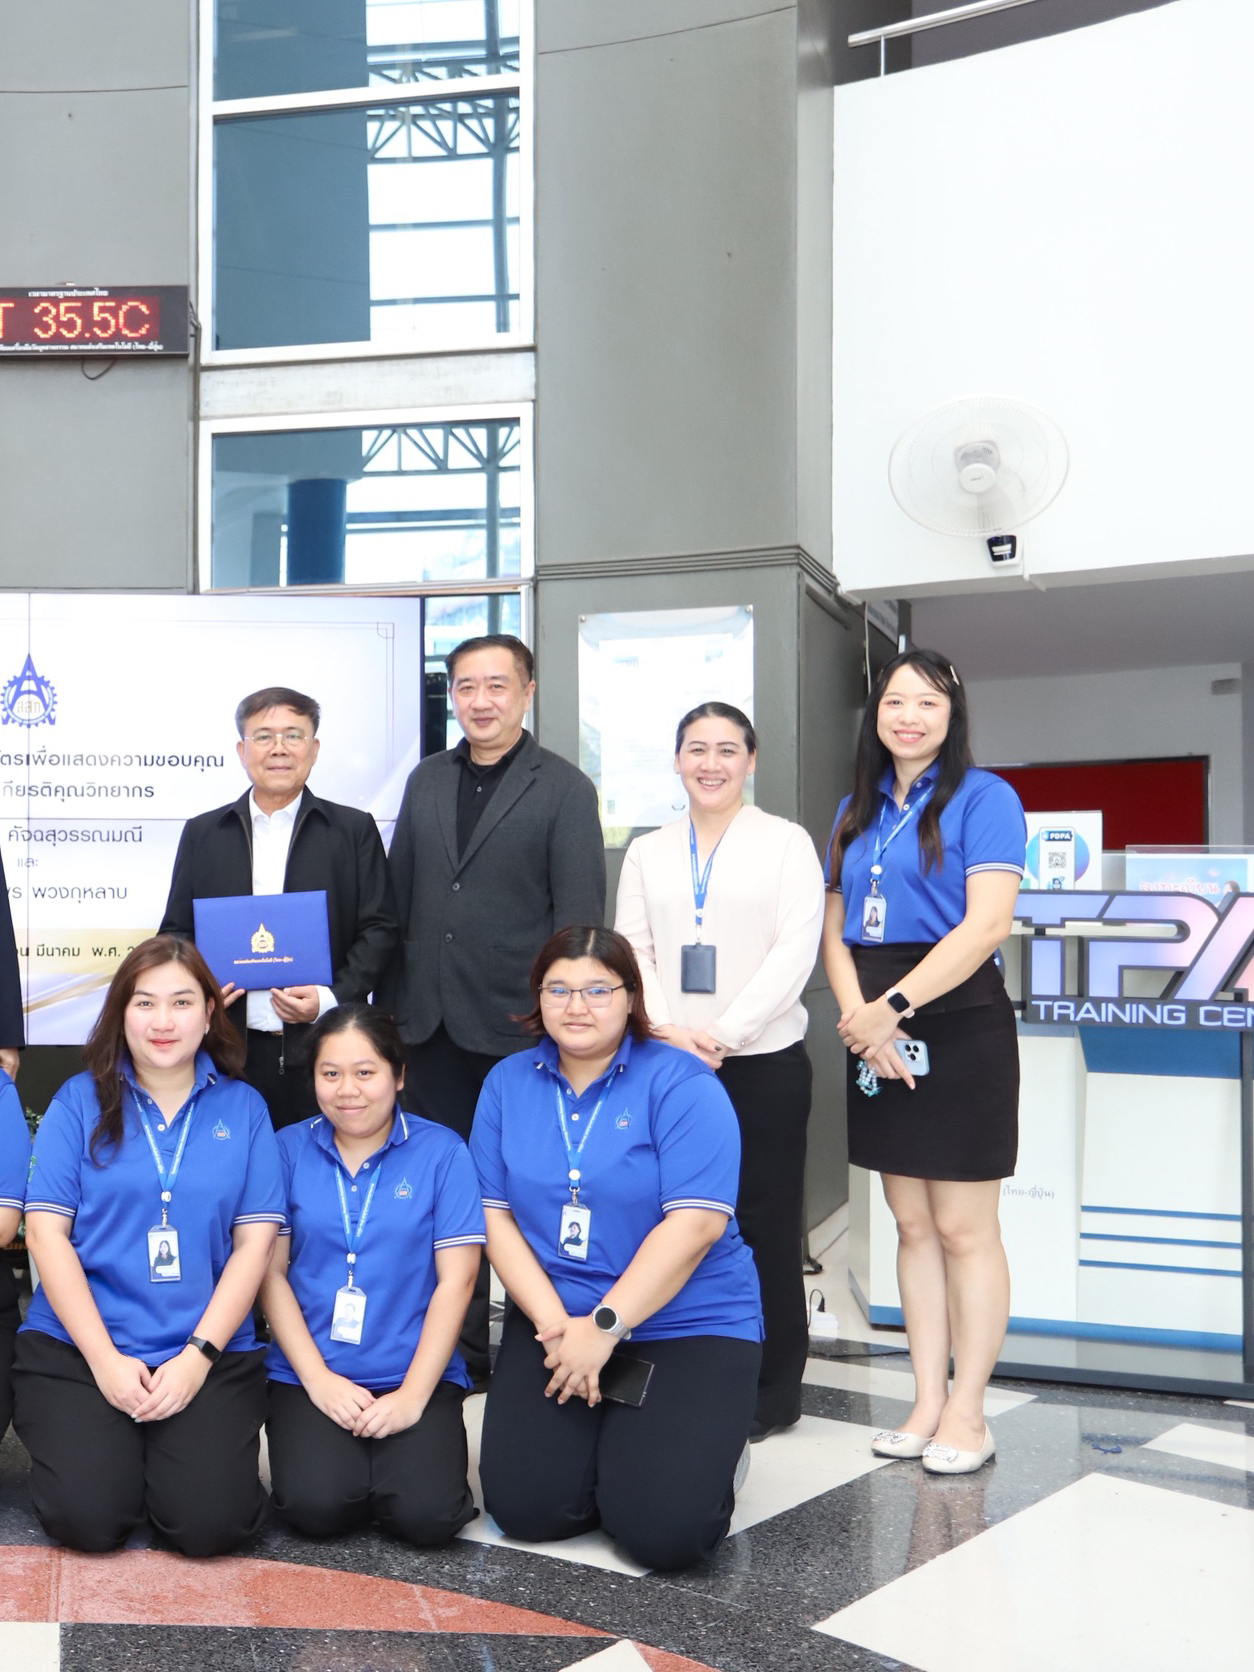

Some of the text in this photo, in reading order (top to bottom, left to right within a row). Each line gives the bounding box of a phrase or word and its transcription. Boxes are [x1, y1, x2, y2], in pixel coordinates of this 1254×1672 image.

[33, 302, 150, 338] 35.5C
[1049, 832, 1072, 840] PDPA
[17, 857, 39, 868] และ
[32, 886, 128, 904] พวงกุหลาบ
[36, 943, 81, 957] มีนาคม
[92, 946, 121, 957] พ.ศ.
[1031, 1001, 1186, 1025] TRAINING
